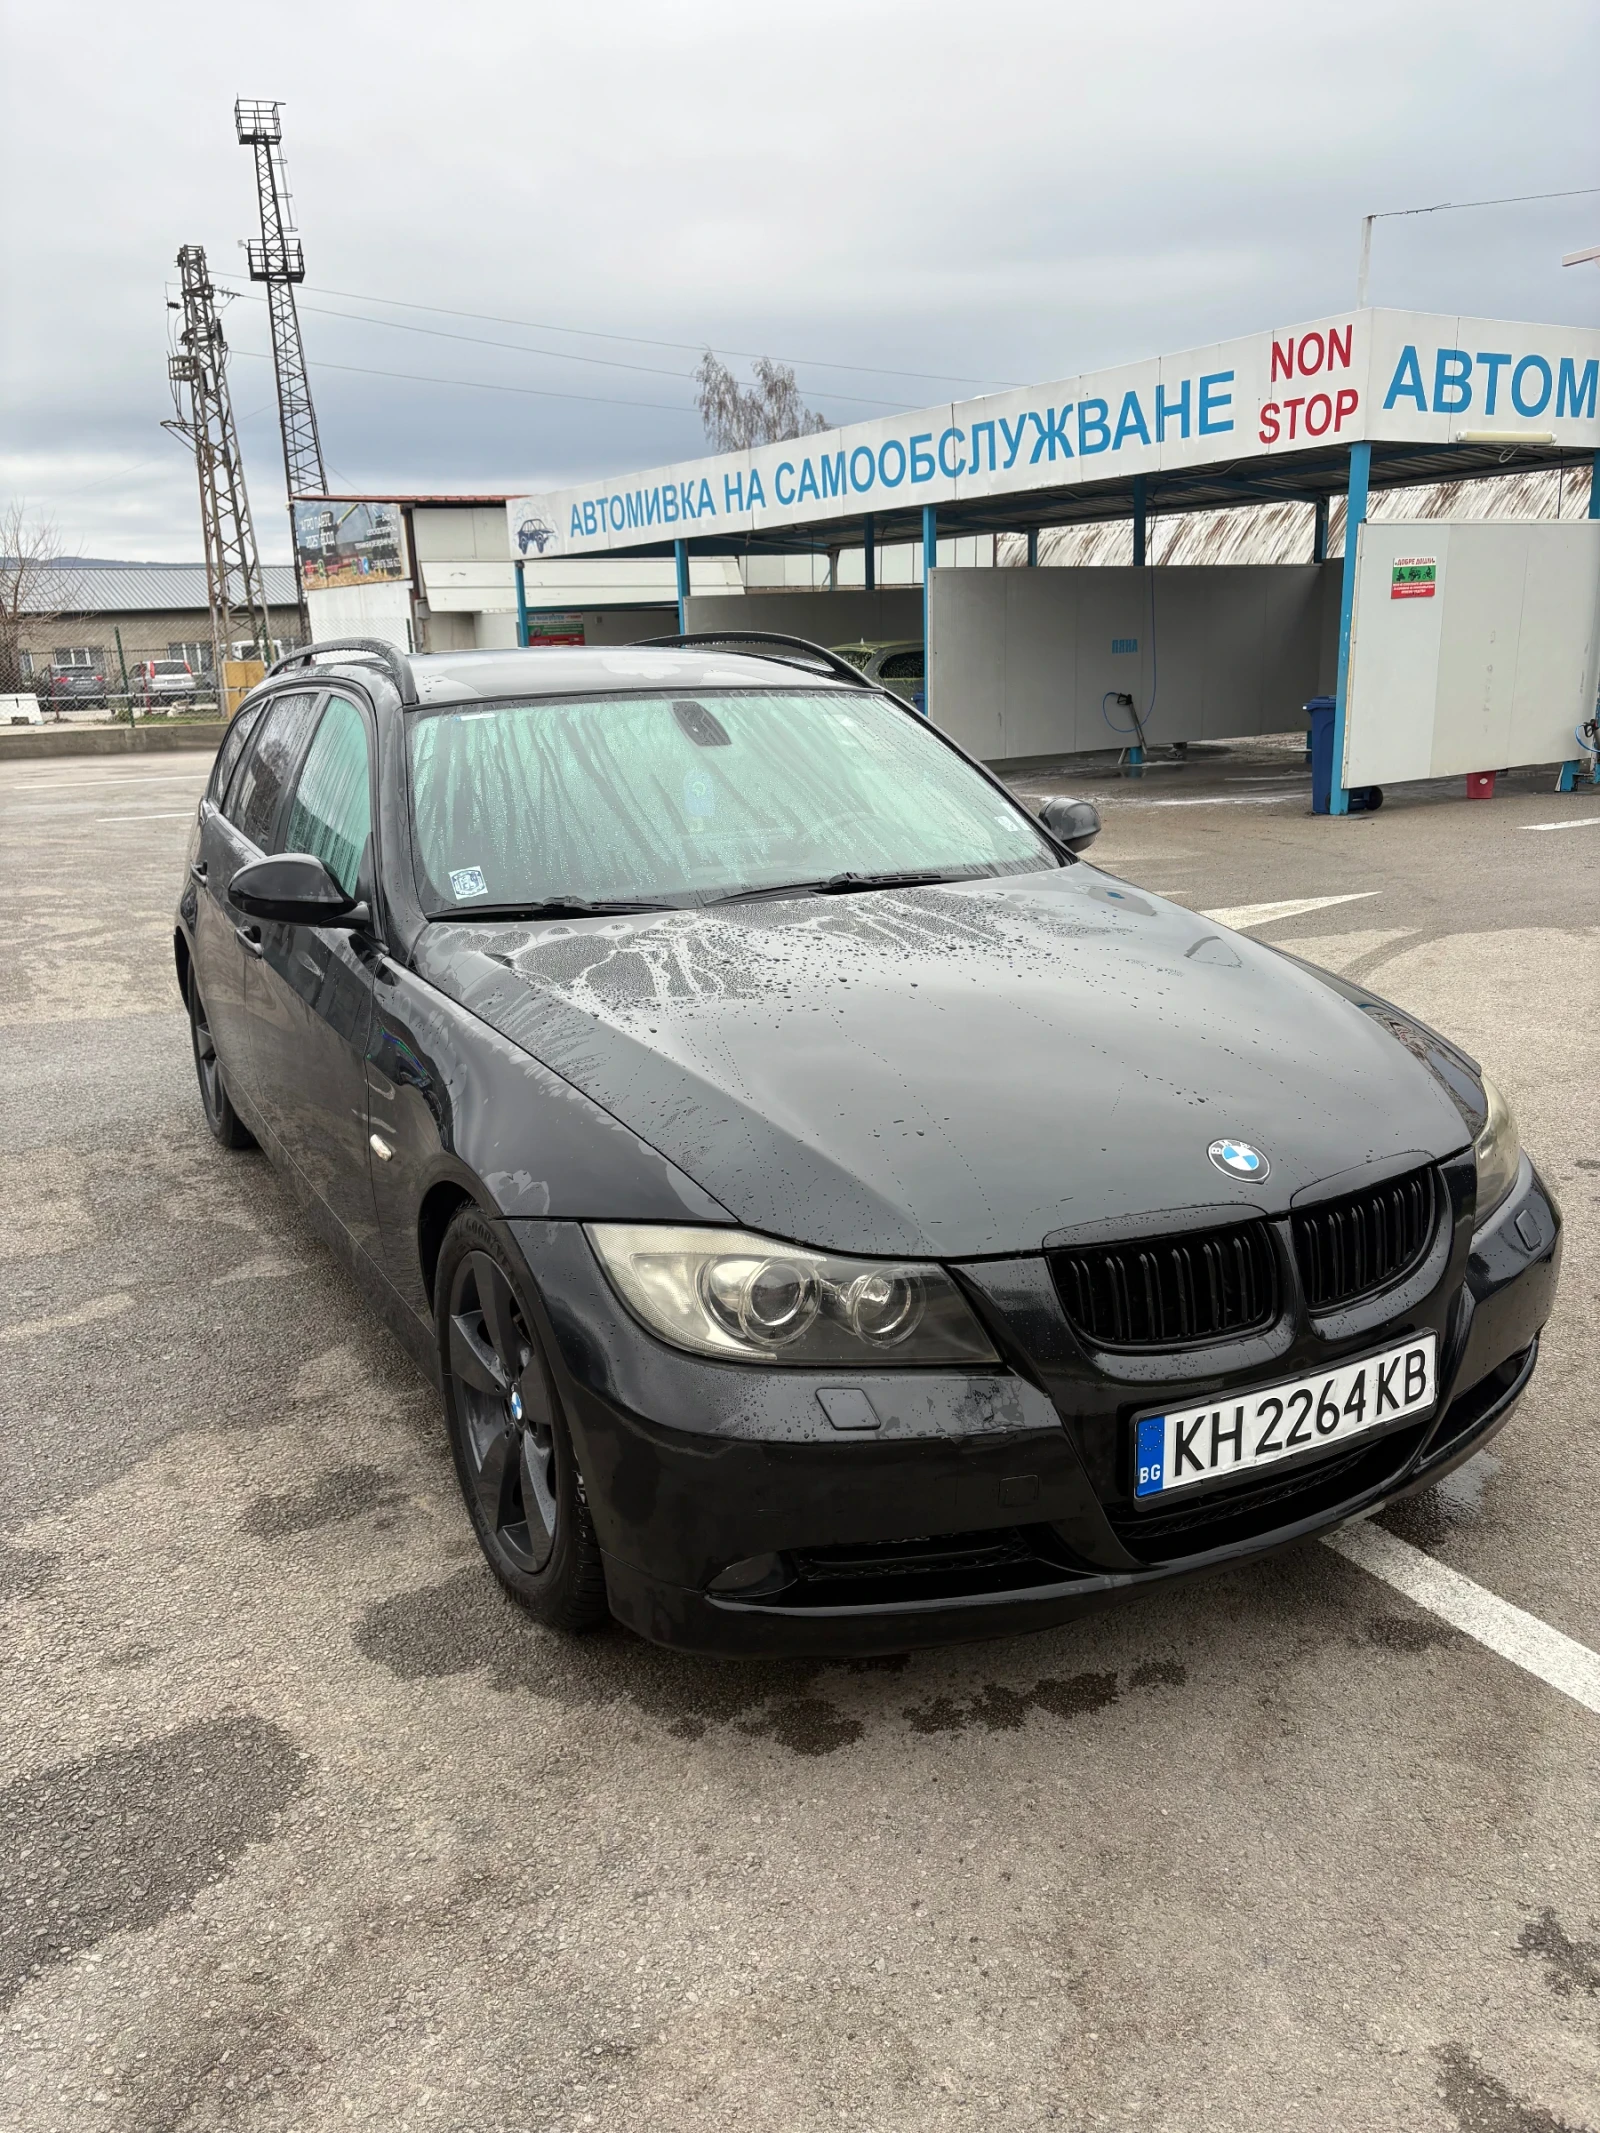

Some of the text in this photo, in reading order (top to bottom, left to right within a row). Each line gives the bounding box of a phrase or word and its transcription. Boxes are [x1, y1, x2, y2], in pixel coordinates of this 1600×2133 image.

[1271, 324, 1353, 382] NON
[1382, 345, 1600, 420] АВТОМ
[1258, 388, 1359, 445] STOP
[570, 370, 1236, 538] АВТОМИВКА НА САМООБСЛУЖВАНЕ
[1112, 639, 1138, 654] ПЯНА
[1139, 1464, 1161, 1485] BG
